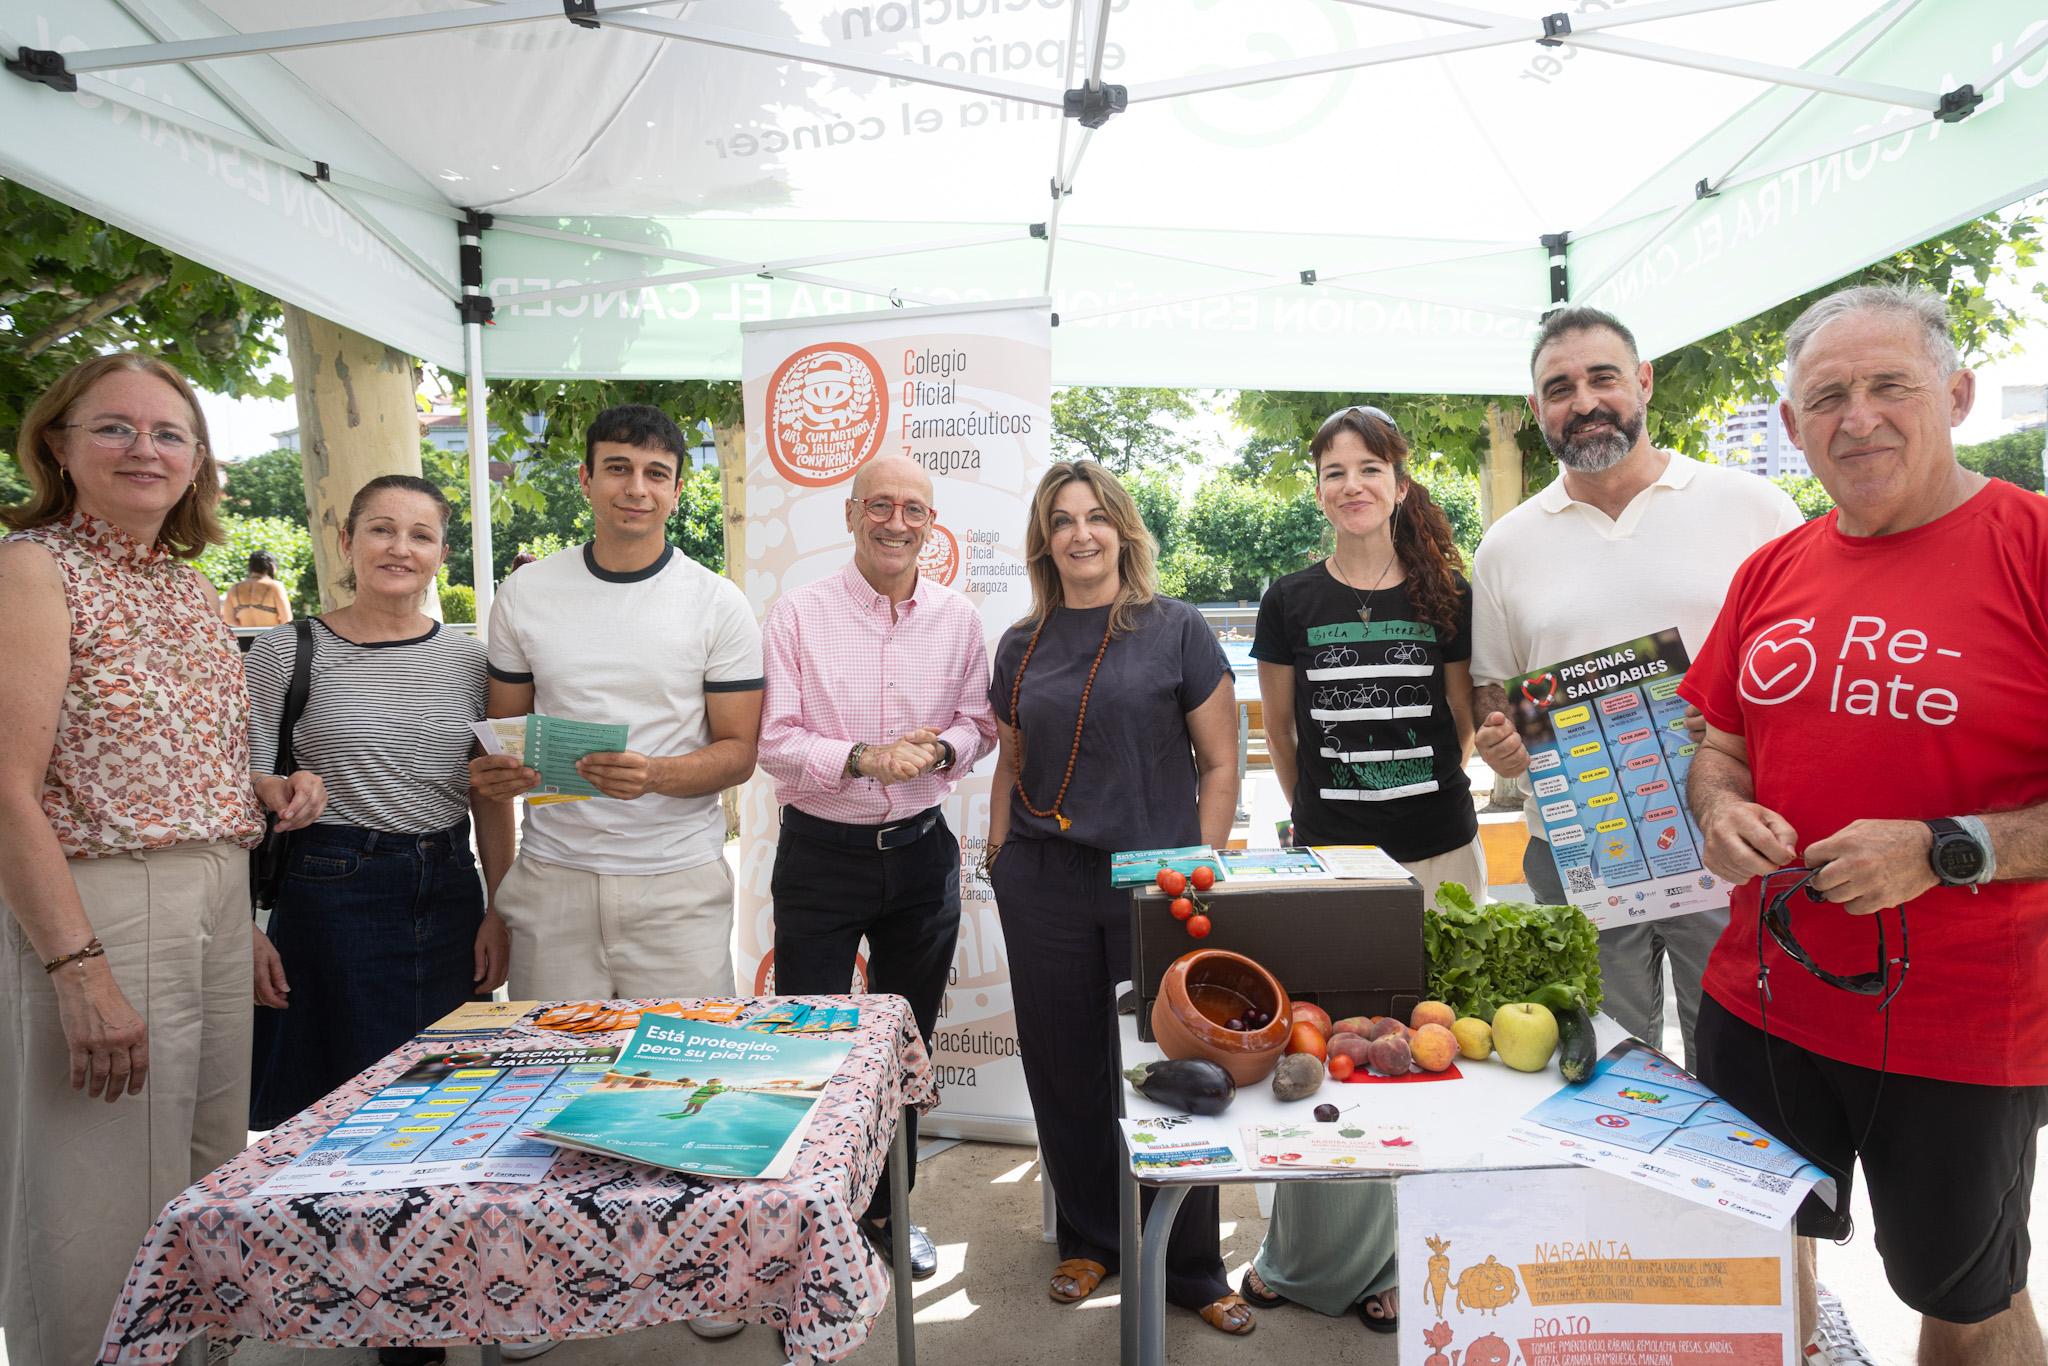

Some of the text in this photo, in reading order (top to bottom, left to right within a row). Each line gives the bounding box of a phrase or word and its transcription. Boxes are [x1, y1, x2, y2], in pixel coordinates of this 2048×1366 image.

[904, 348, 967, 378] Colegio
[903, 379, 956, 408] Oficial
[782, 419, 871, 443] ARS CUM NATURA
[902, 411, 1031, 440] Farmacéuticos
[792, 443, 809, 455] AD
[796, 451, 855, 467] CONSPIRANS
[966, 529, 1000, 545] Colegio
[966, 546, 994, 560] Oficial
[965, 579, 1008, 595] Zaragoza
[1839, 615, 1962, 664] Re-
[1560, 648, 1636, 682] PISCINAS
[1566, 659, 1669, 699] SALUDABLES
[1830, 665, 1959, 726] late
[646, 1025, 781, 1053] Está protegido,
[491, 1056, 612, 1067] SALUDABLES
[499, 1050, 588, 1059] PISCINAS
[637, 1043, 775, 1061] pero su piel no.
[1730, 1202, 1772, 1219] Zaragoza
[1535, 1240, 1632, 1263] NARANJA
[1534, 1316, 1591, 1338] ROJO
